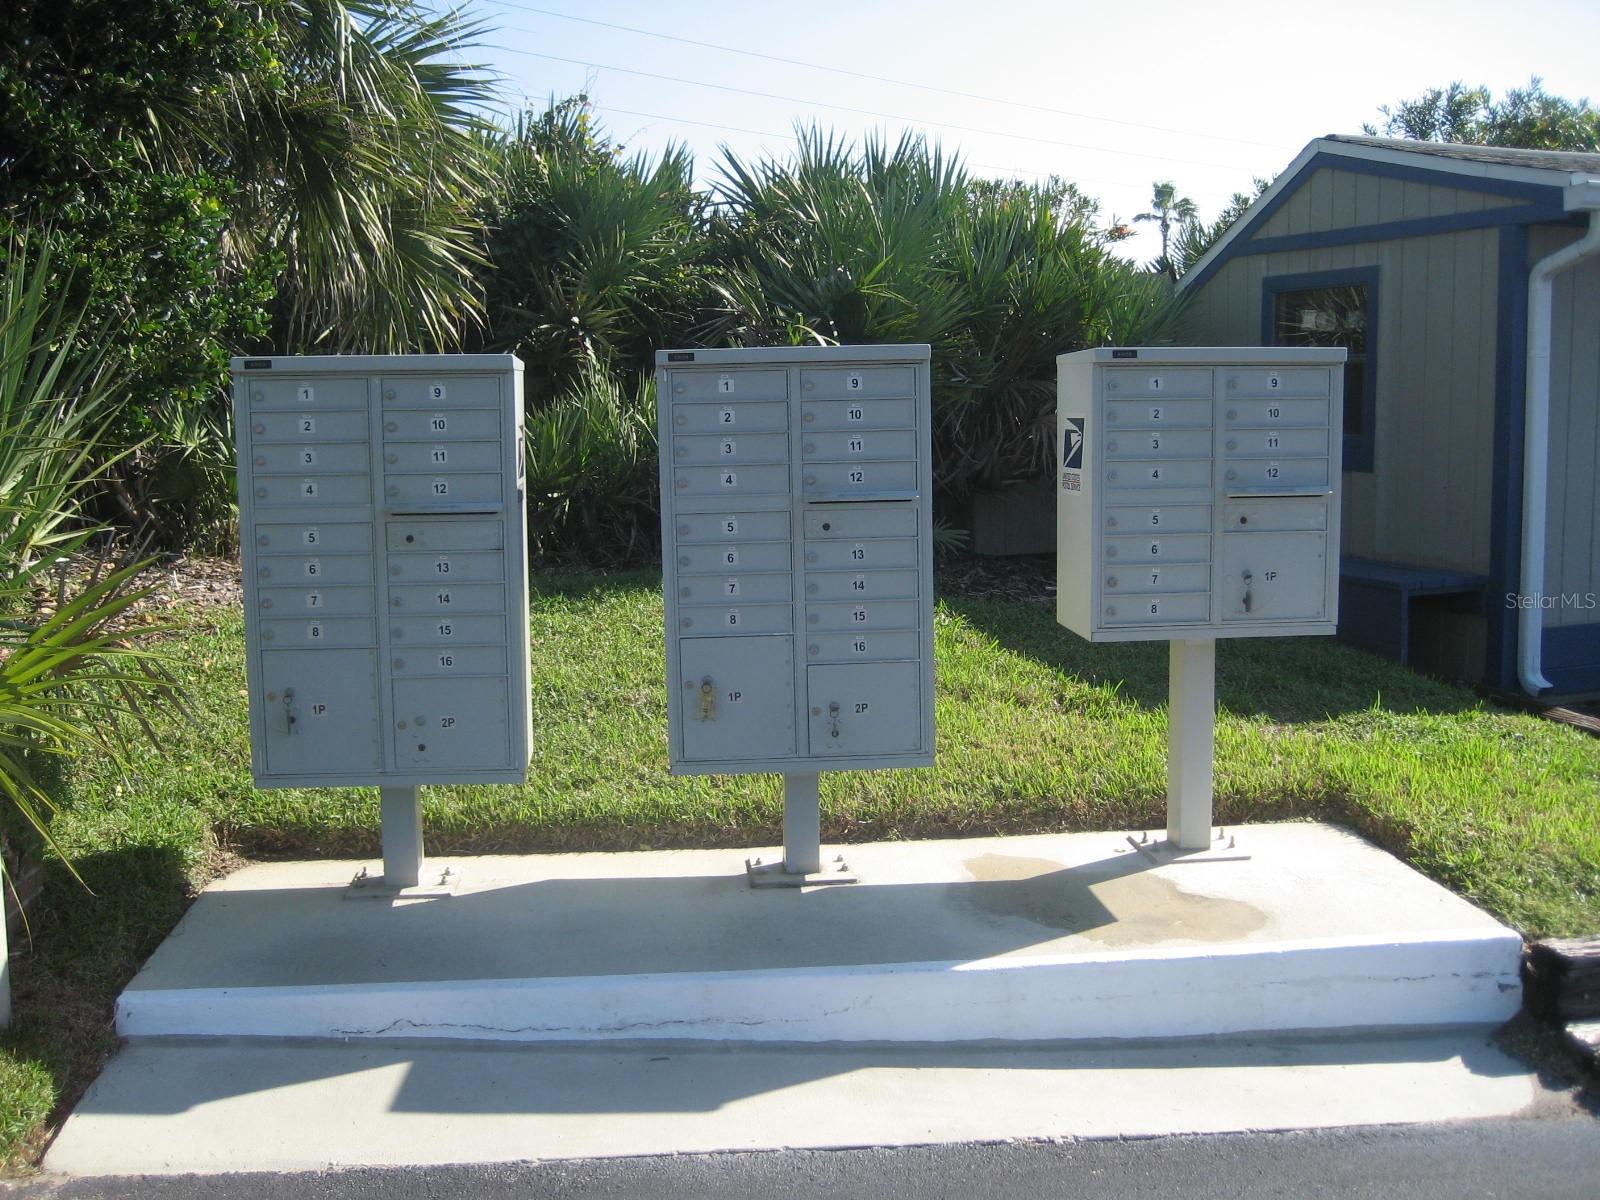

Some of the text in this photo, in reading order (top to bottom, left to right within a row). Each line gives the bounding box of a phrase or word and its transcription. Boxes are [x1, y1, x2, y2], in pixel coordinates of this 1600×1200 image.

[723, 381, 729, 391] 1
[851, 378, 859, 389] 9
[1153, 379, 1159, 388] 1
[1271, 378, 1278, 388] 9
[303, 389, 309, 400] 1
[433, 387, 441, 398] 9
[724, 412, 731, 423] 2
[849, 409, 862, 420] 10
[1153, 408, 1160, 419] 2
[1268, 408, 1280, 418] 10
[304, 421, 311, 432] 2
[432, 419, 446, 430] 10
[725, 443, 732, 454] 3
[850, 441, 861, 451] 11
[1152, 439, 1159, 449] 3
[1268, 438, 1278, 448] 11
[305, 453, 312, 463] 3
[433, 451, 445, 462] 11
[850, 471, 863, 482] 12
[1152, 469, 1159, 479] 4
[1267, 468, 1279, 478] 12
[725, 474, 733, 485] 4
[306, 485, 314, 495] 4
[433, 483, 447, 494] 12
[1152, 515, 1159, 525] 5
[727, 521, 734, 533] 5
[308, 532, 316, 543] 5
[851, 549, 864, 560] 13
[1151, 544, 1158, 555] 6
[727, 553, 734, 563] 6
[309, 564, 316, 575] 6
[436, 562, 450, 573] 13
[1151, 574, 1159, 585] 7
[1264, 570, 1278, 581] 1P
[728, 583, 736, 594] 7
[852, 580, 865, 590] 14
[311, 595, 318, 606] 7
[438, 594, 450, 604] 14
[1151, 604, 1158, 614] 8
[729, 614, 737, 625] 8
[854, 611, 866, 621] 15
[312, 626, 319, 637] 8
[439, 625, 452, 635] 15
[854, 641, 866, 652] 16
[441, 656, 453, 667] 16
[728, 692, 742, 702] 1P
[313, 704, 326, 715] 1P
[855, 703, 868, 714] 2P
[441, 717, 455, 728] 2P
